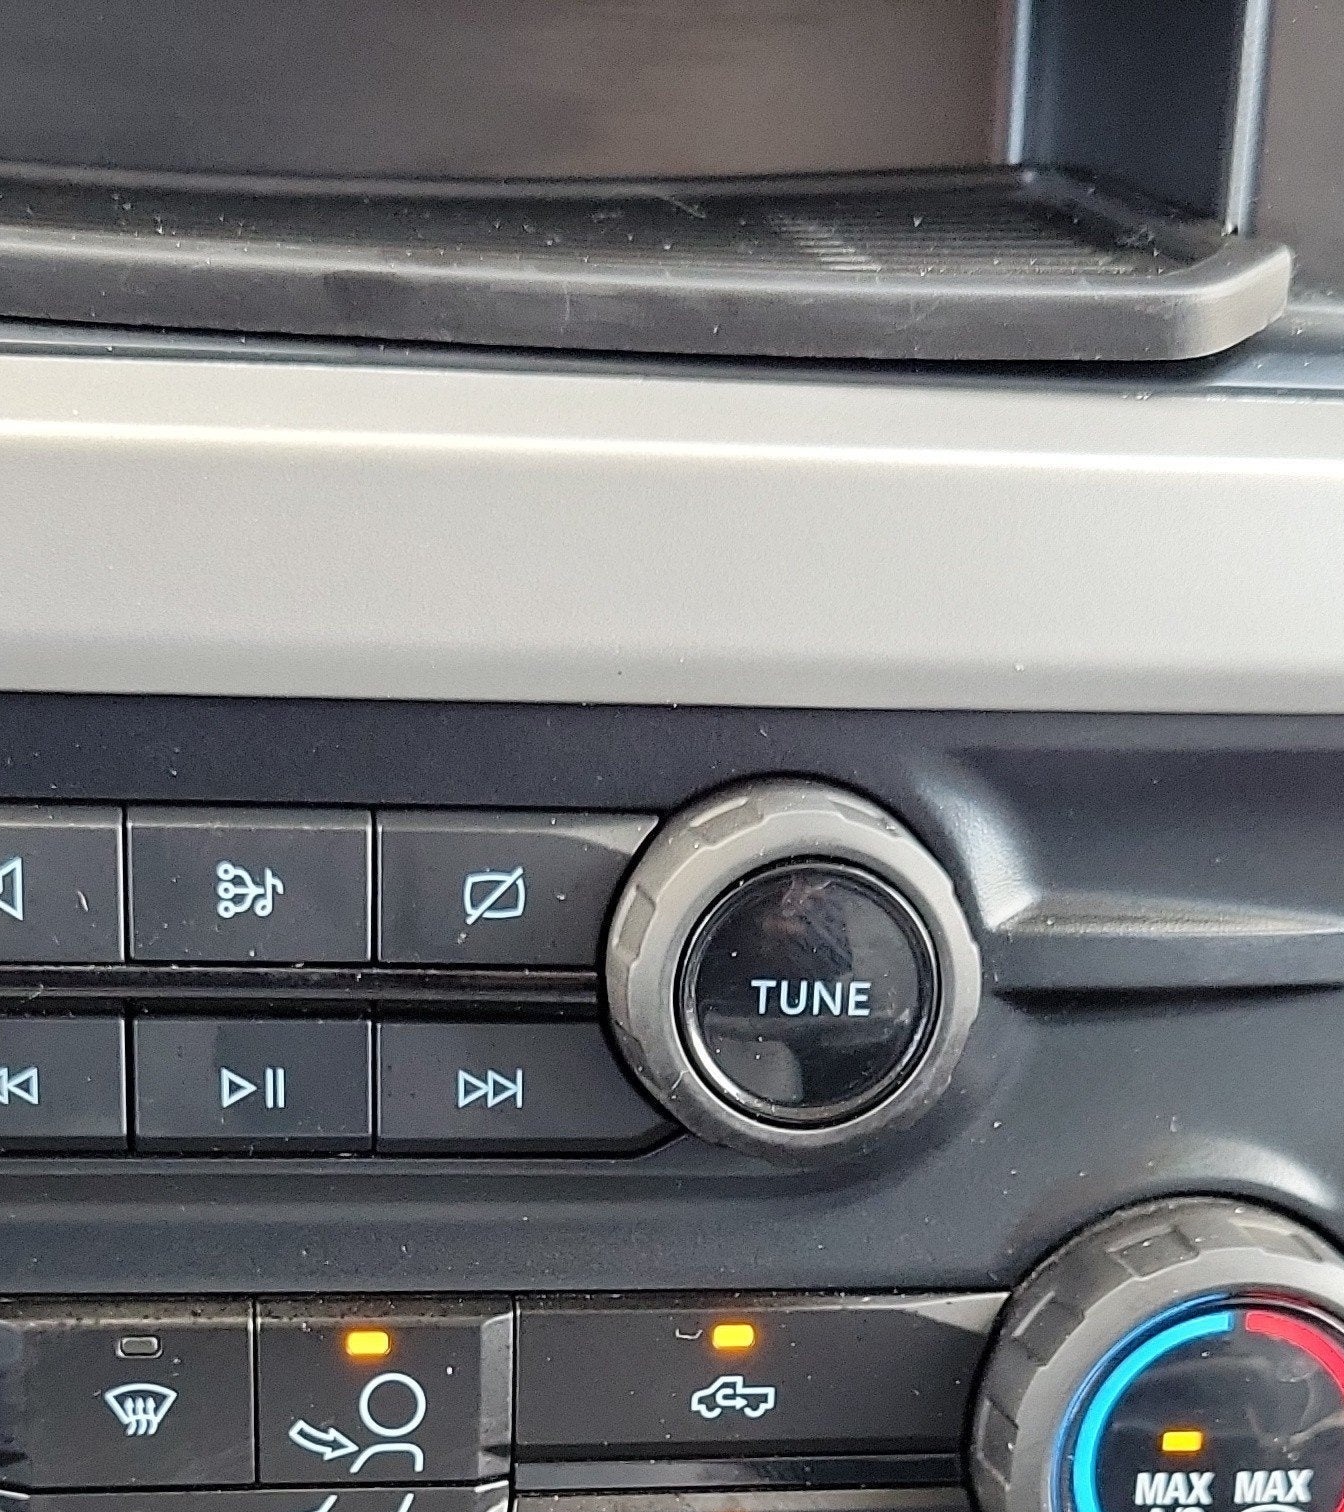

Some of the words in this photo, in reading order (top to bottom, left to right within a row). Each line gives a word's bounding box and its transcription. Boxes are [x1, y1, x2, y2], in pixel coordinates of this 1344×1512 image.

[750, 979, 872, 1016] TUNE
[1134, 1471, 1215, 1506] MAX
[1233, 1468, 1314, 1505] MAX
